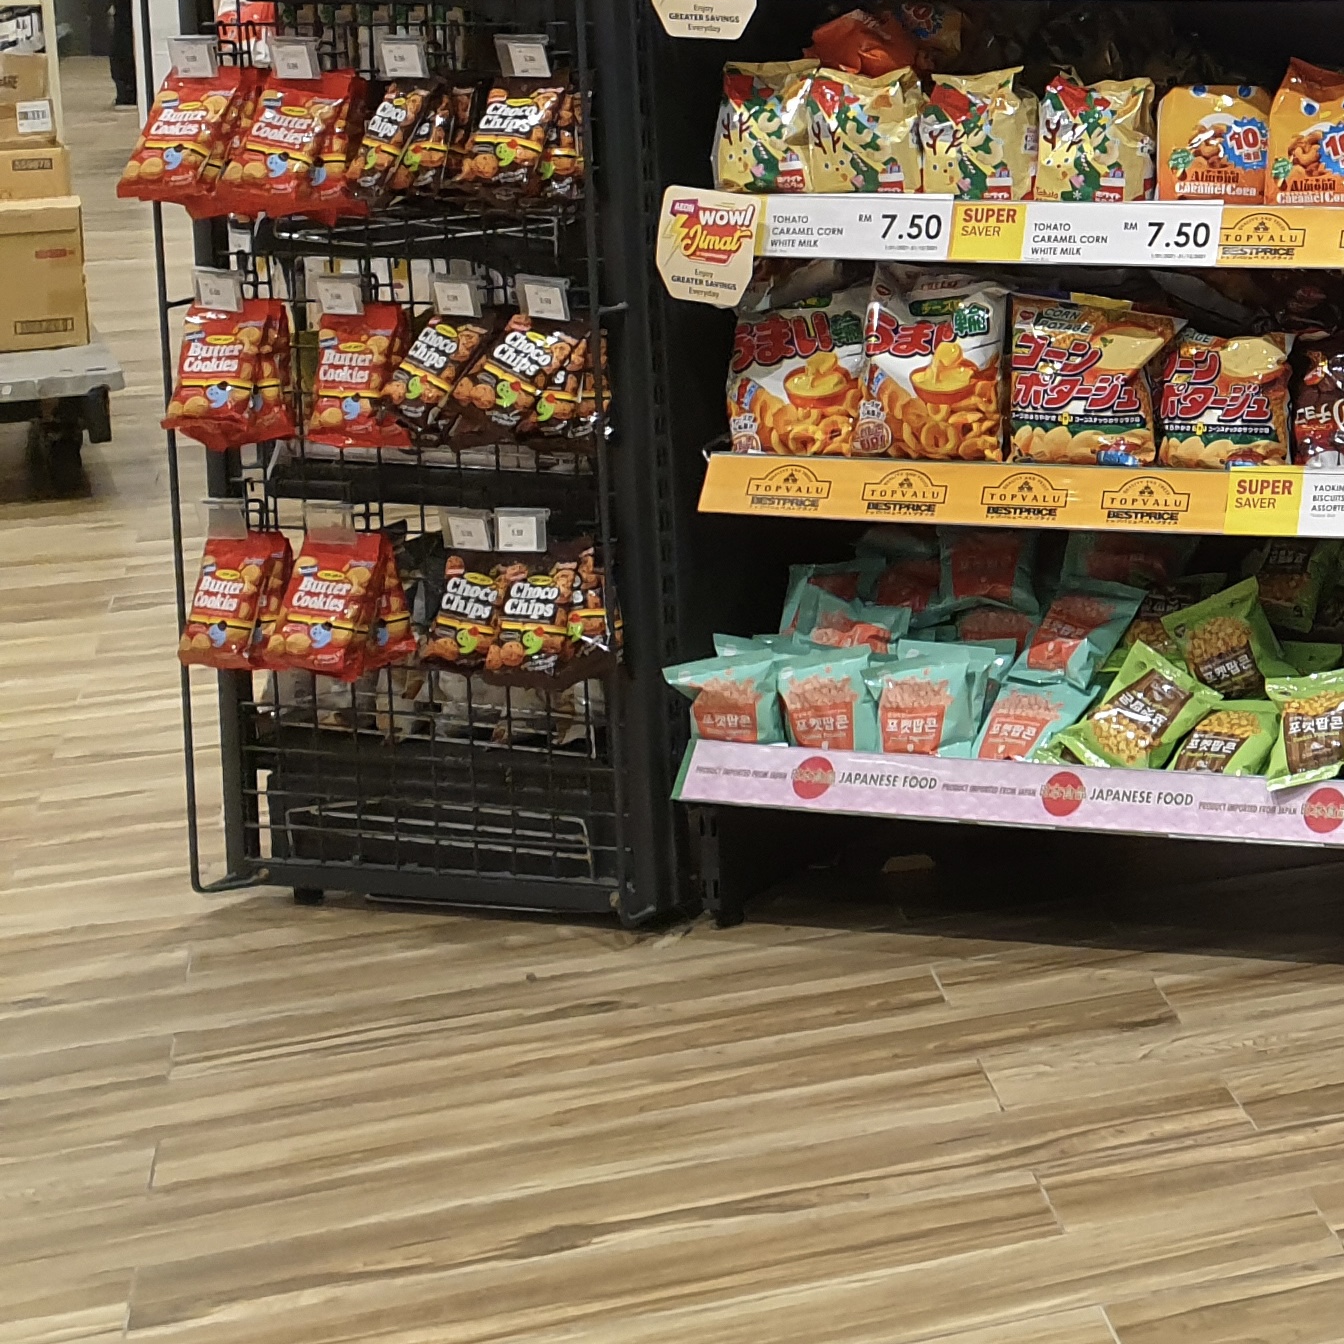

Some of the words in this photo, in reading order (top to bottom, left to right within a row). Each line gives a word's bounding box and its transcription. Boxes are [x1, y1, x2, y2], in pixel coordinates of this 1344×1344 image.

[772, 227, 814, 236] CARAMEL
[817, 227, 844, 236] CORN
[881, 214, 942, 240] 7.50
[771, 239, 795, 248] WHITE
[798, 239, 819, 248] MILK
[188, 342, 243, 357] Butter
[183, 358, 239, 373] Cookies
[510, 582, 558, 600] Choco
[504, 599, 554, 618] Chips
[839, 772, 899, 787] JAPANESE
[903, 775, 937, 790] FOOD
